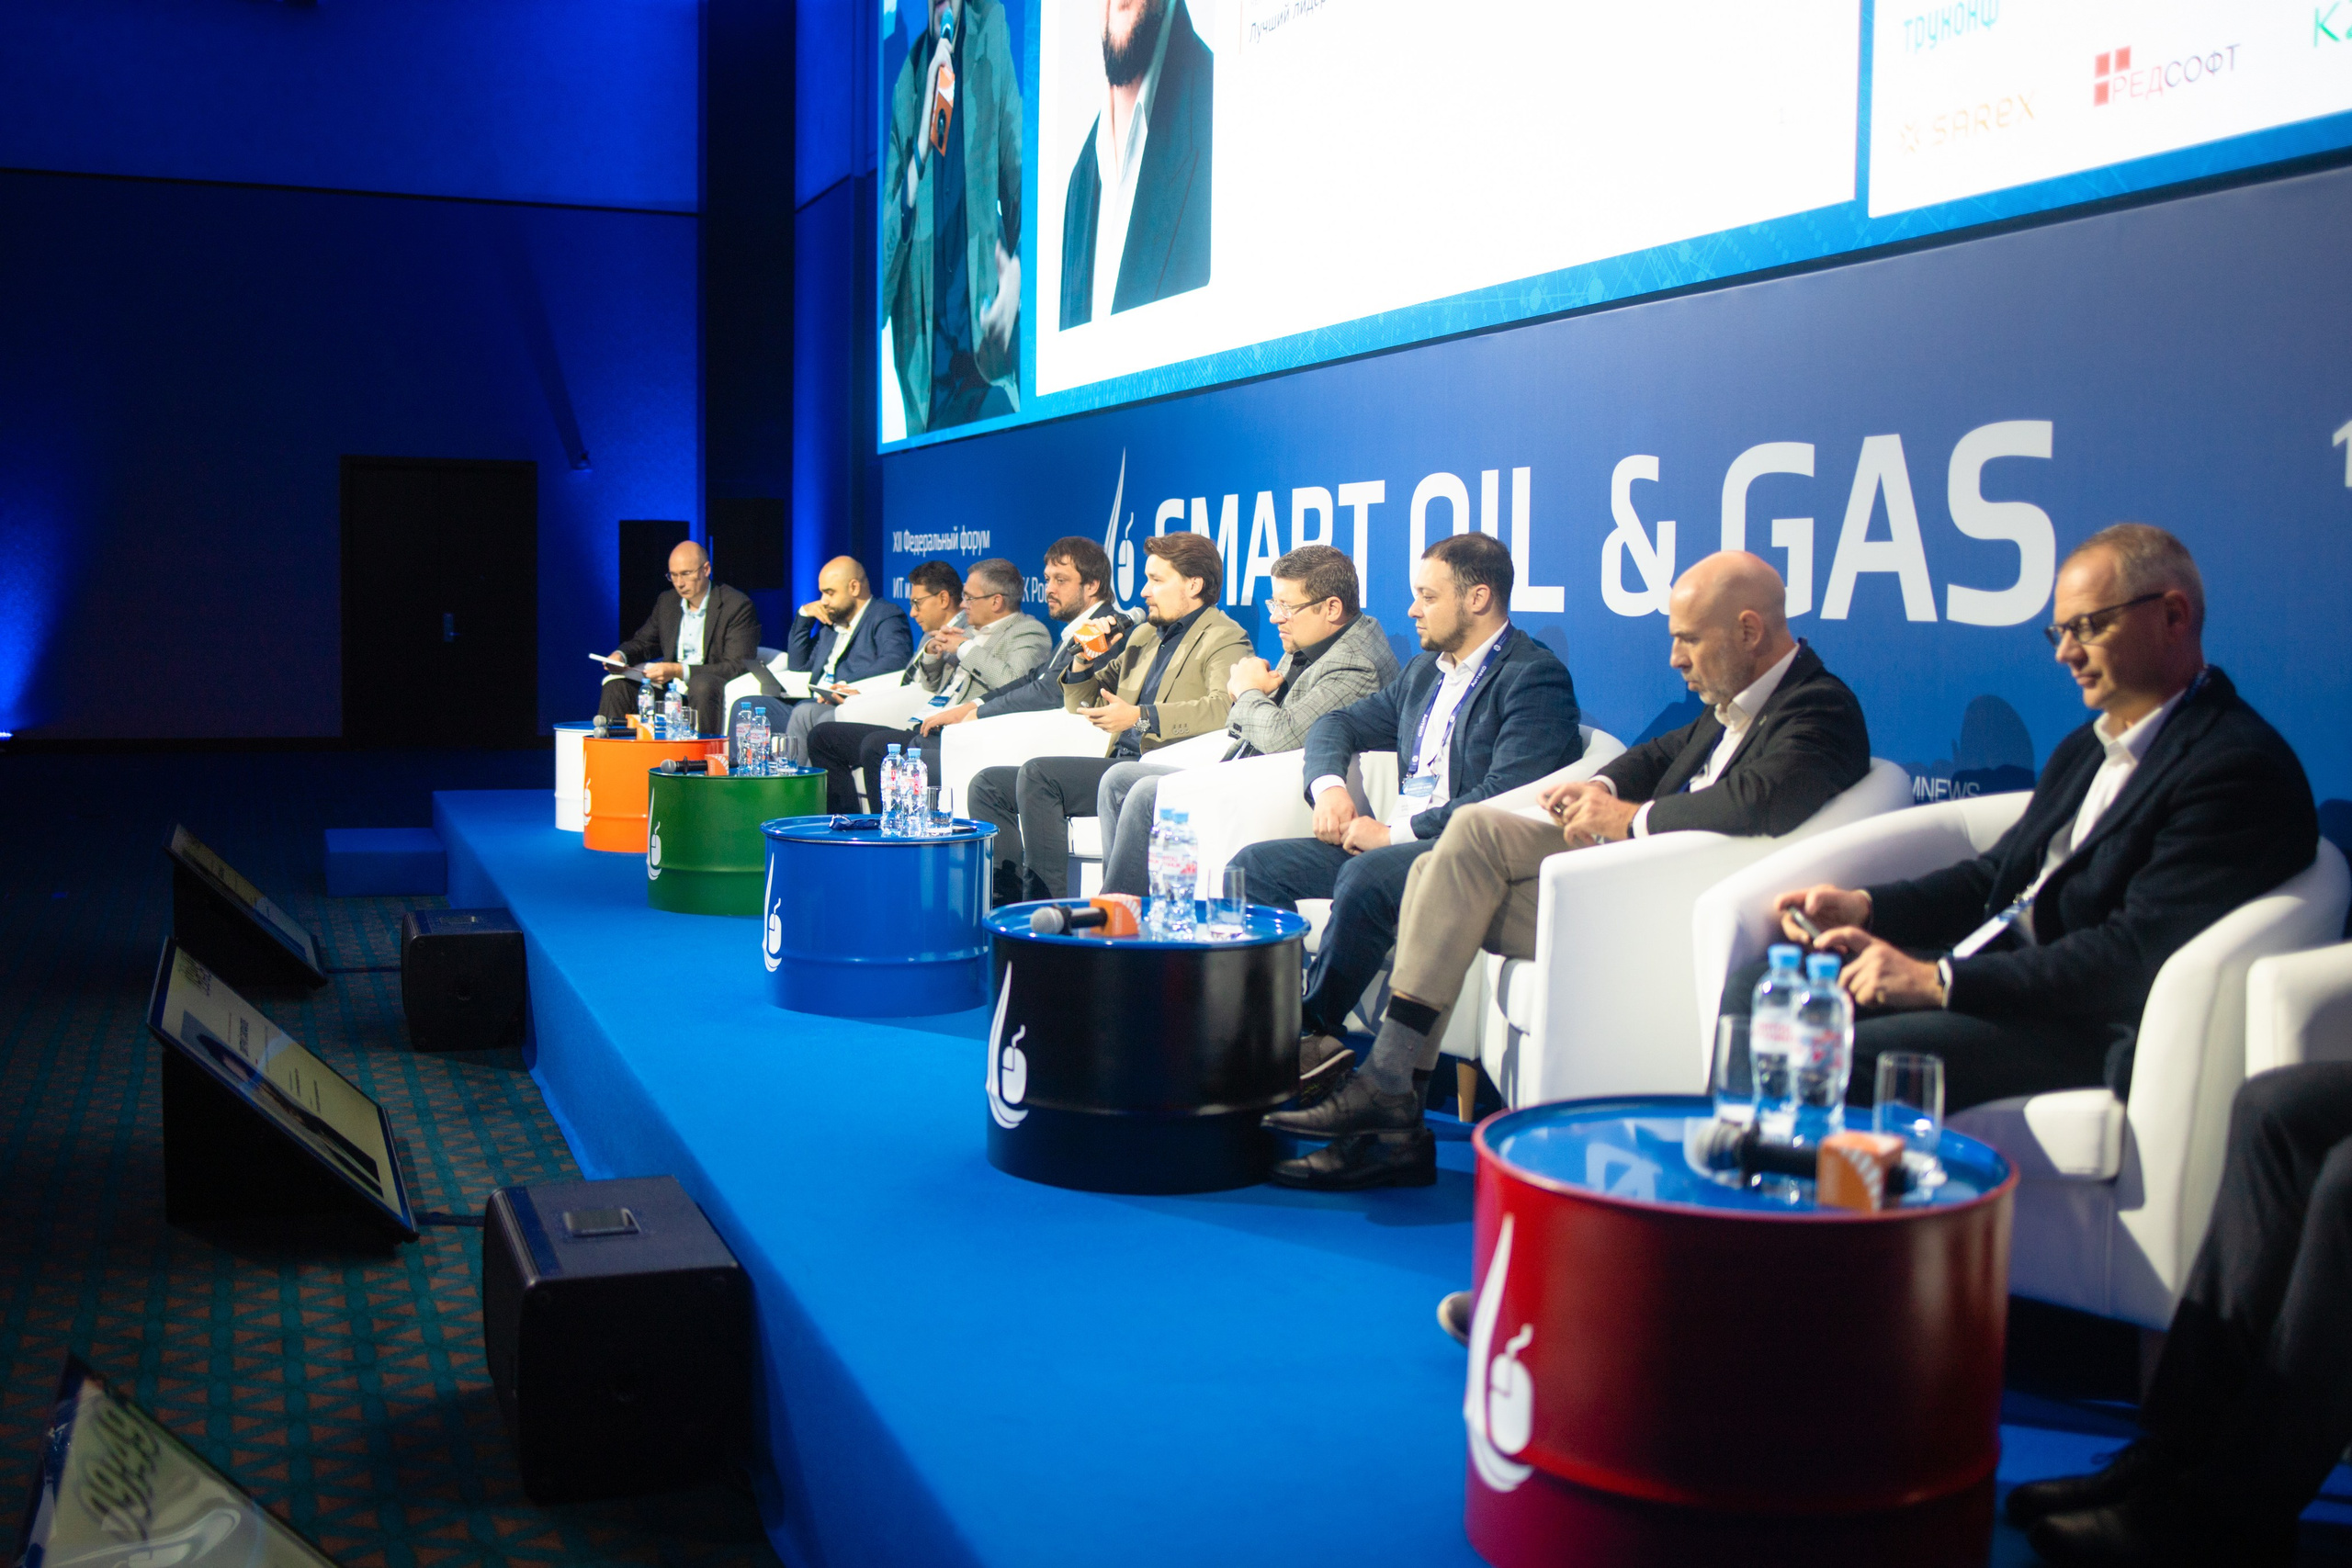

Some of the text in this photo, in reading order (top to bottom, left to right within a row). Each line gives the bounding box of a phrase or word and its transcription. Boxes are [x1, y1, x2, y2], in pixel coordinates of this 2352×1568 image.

[1409, 467, 1565, 613] OIL
[1600, 455, 1676, 617] &
[1721, 420, 2056, 627] GAS
[904, 526, 958, 558] Федеральный
[960, 525, 990, 556] форум
[893, 577, 904, 598] ИТ
